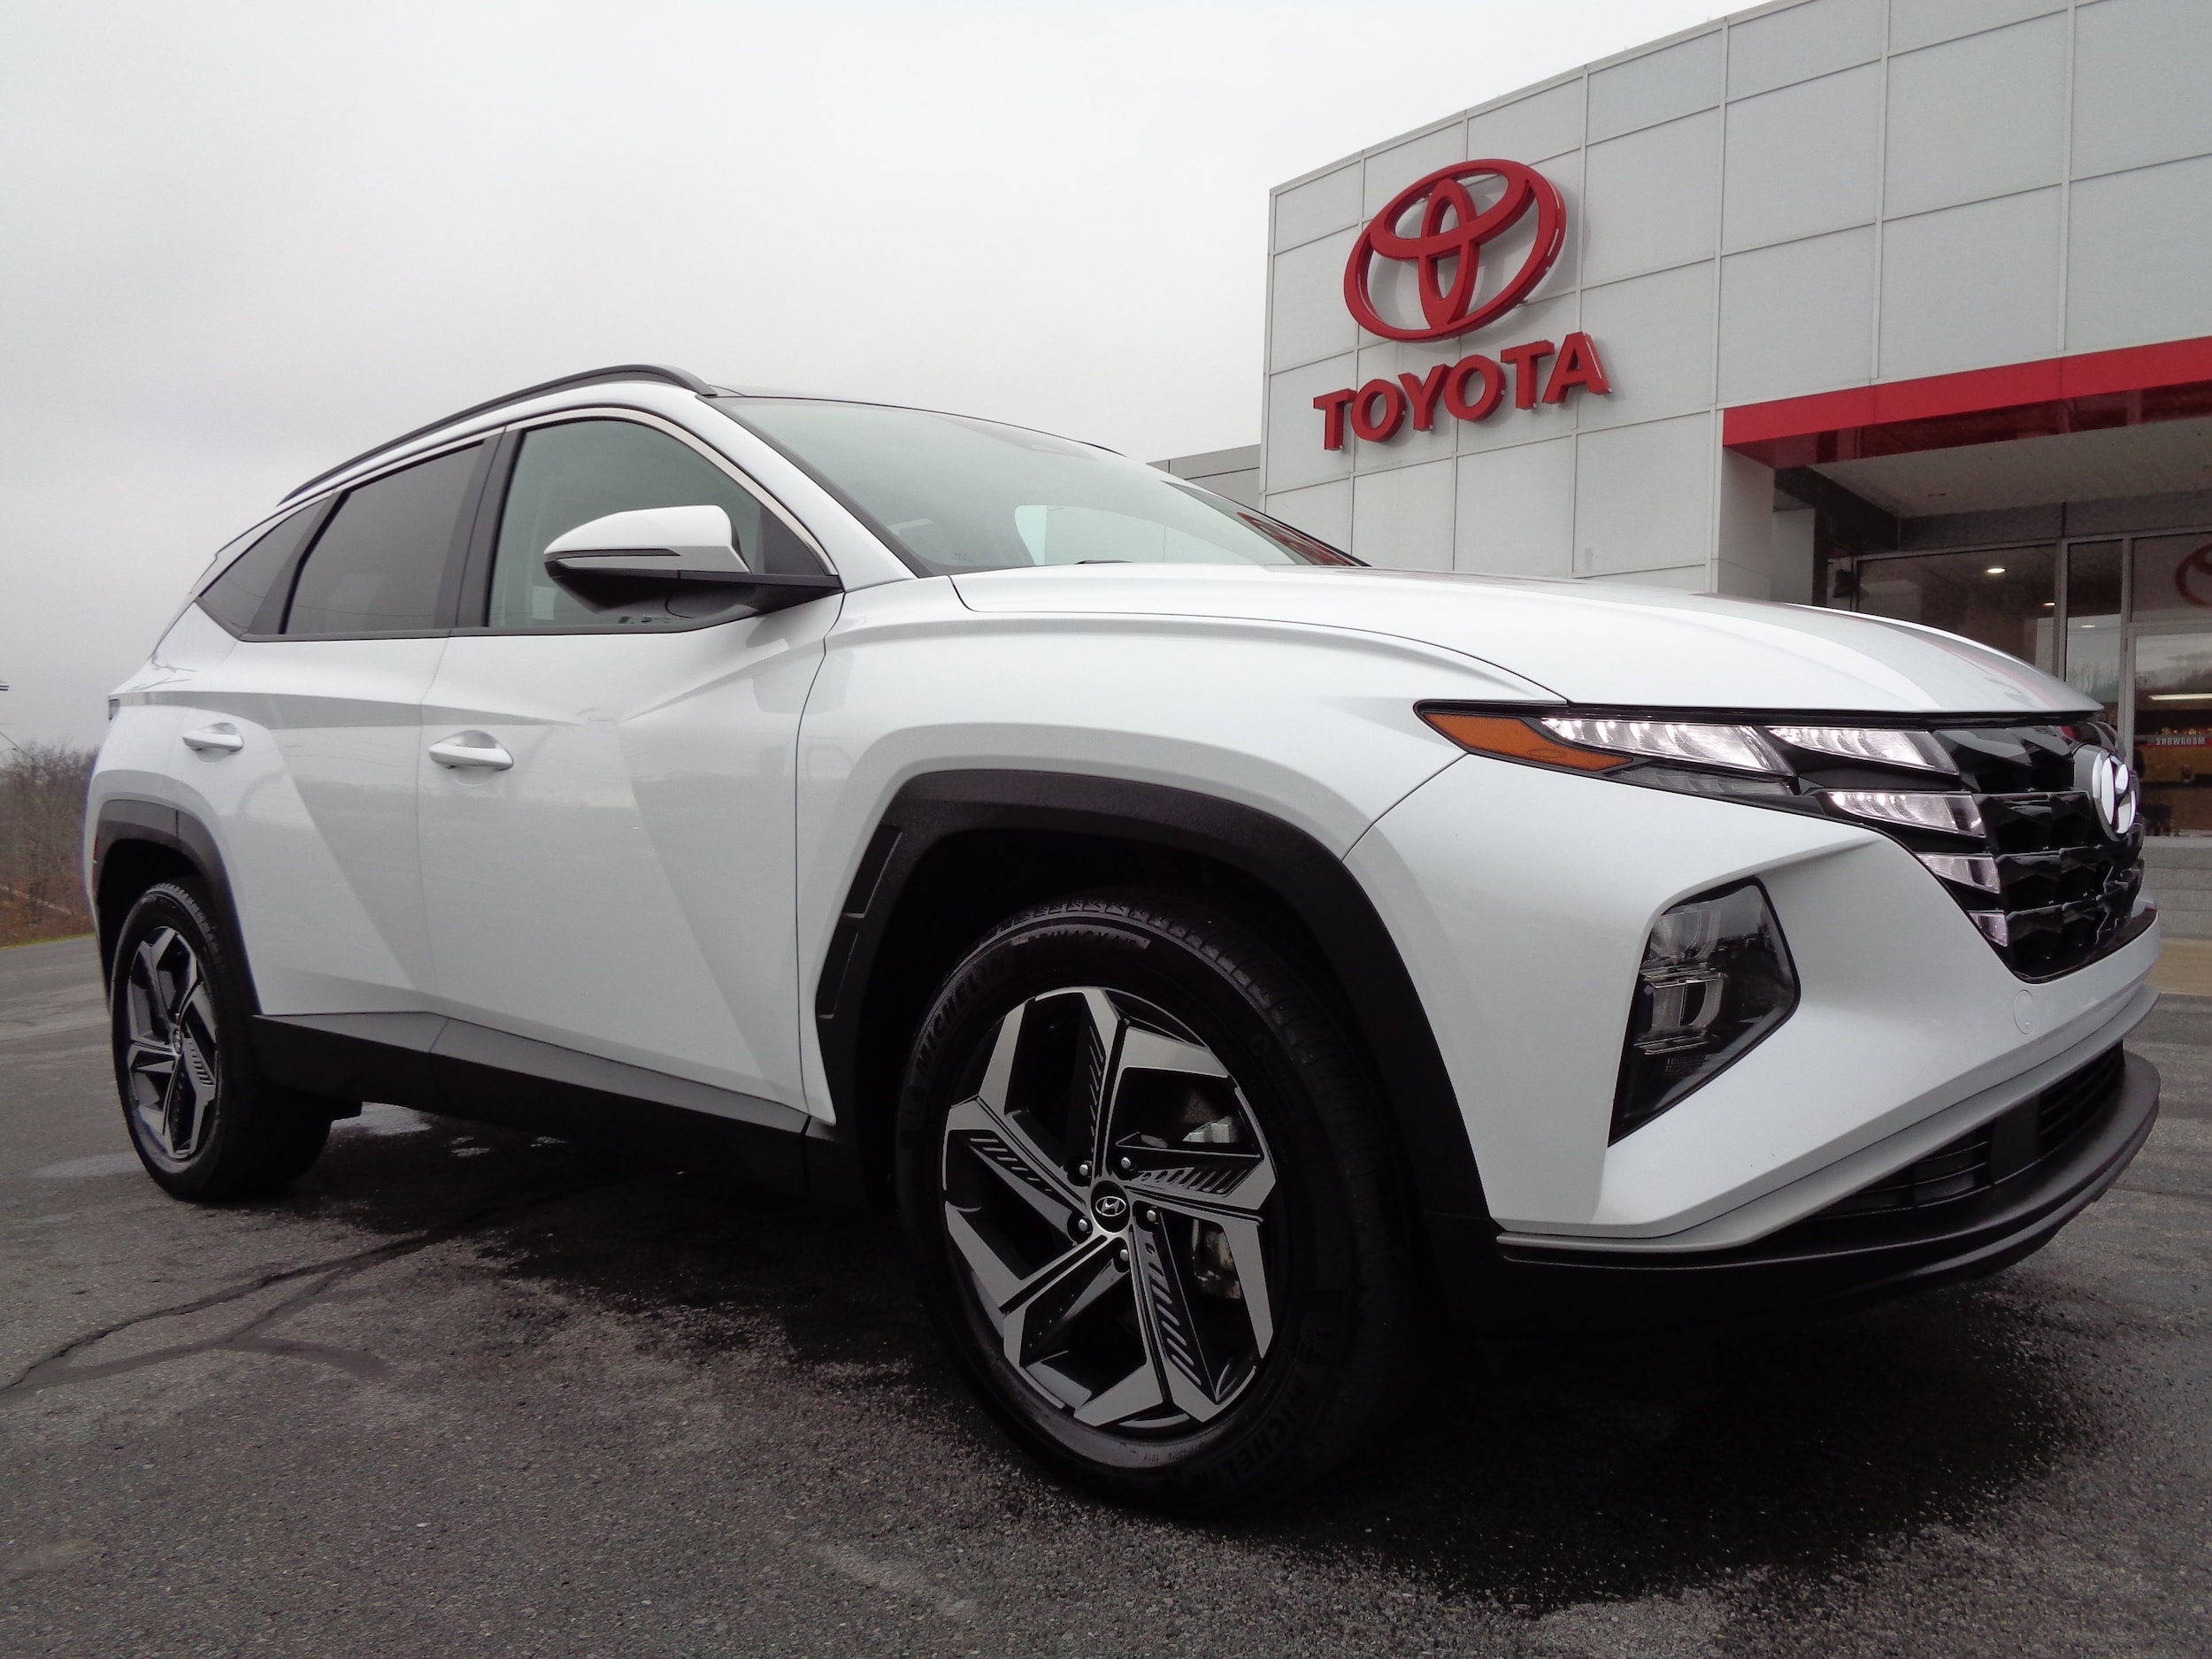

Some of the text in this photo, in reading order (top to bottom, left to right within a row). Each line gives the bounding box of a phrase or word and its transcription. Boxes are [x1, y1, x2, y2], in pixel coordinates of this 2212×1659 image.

[1313, 332, 1612, 450] TOYOTA
[2155, 736, 2205, 746] SHOWROOM
[916, 956, 1007, 1077] MICHELIN
[1192, 1373, 1308, 1492] MICHELIN
